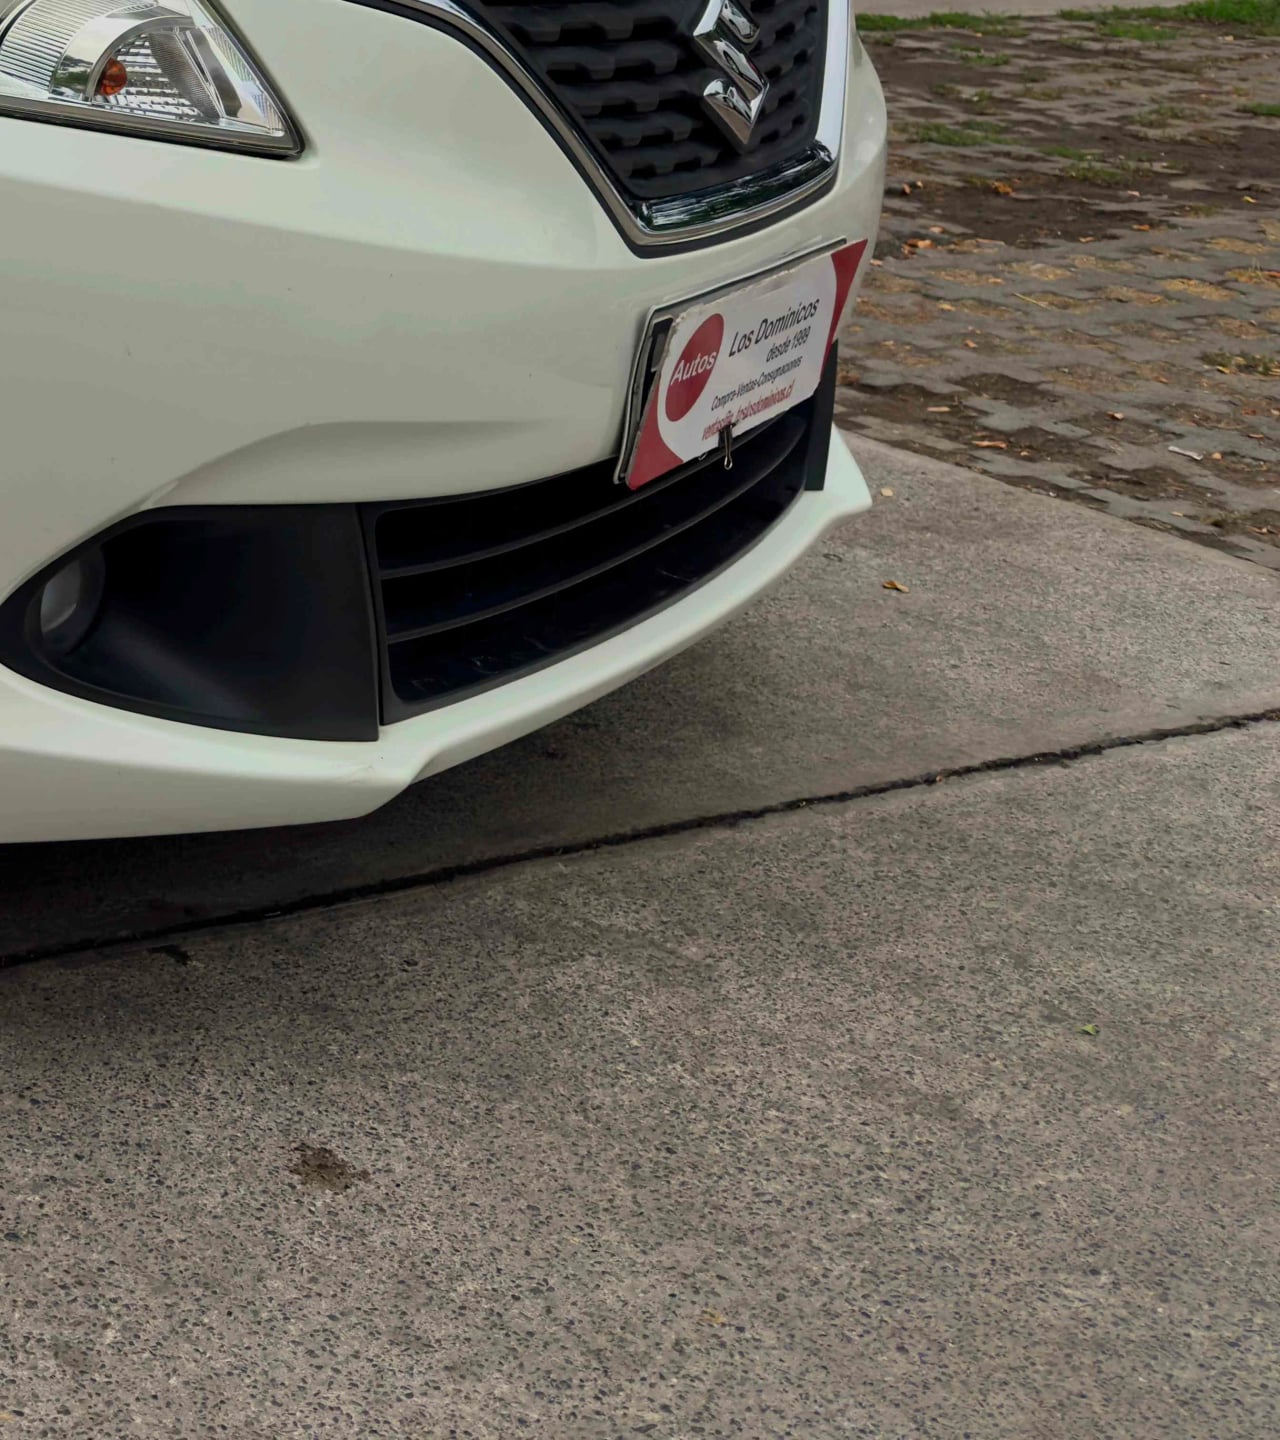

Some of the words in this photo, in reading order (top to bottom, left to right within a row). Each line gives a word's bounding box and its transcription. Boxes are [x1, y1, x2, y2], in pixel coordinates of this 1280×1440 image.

[728, 329, 754, 357] Los
[755, 298, 820, 344] Dominicos
[670, 350, 717, 386] Autos
[766, 340, 791, 362] desde
